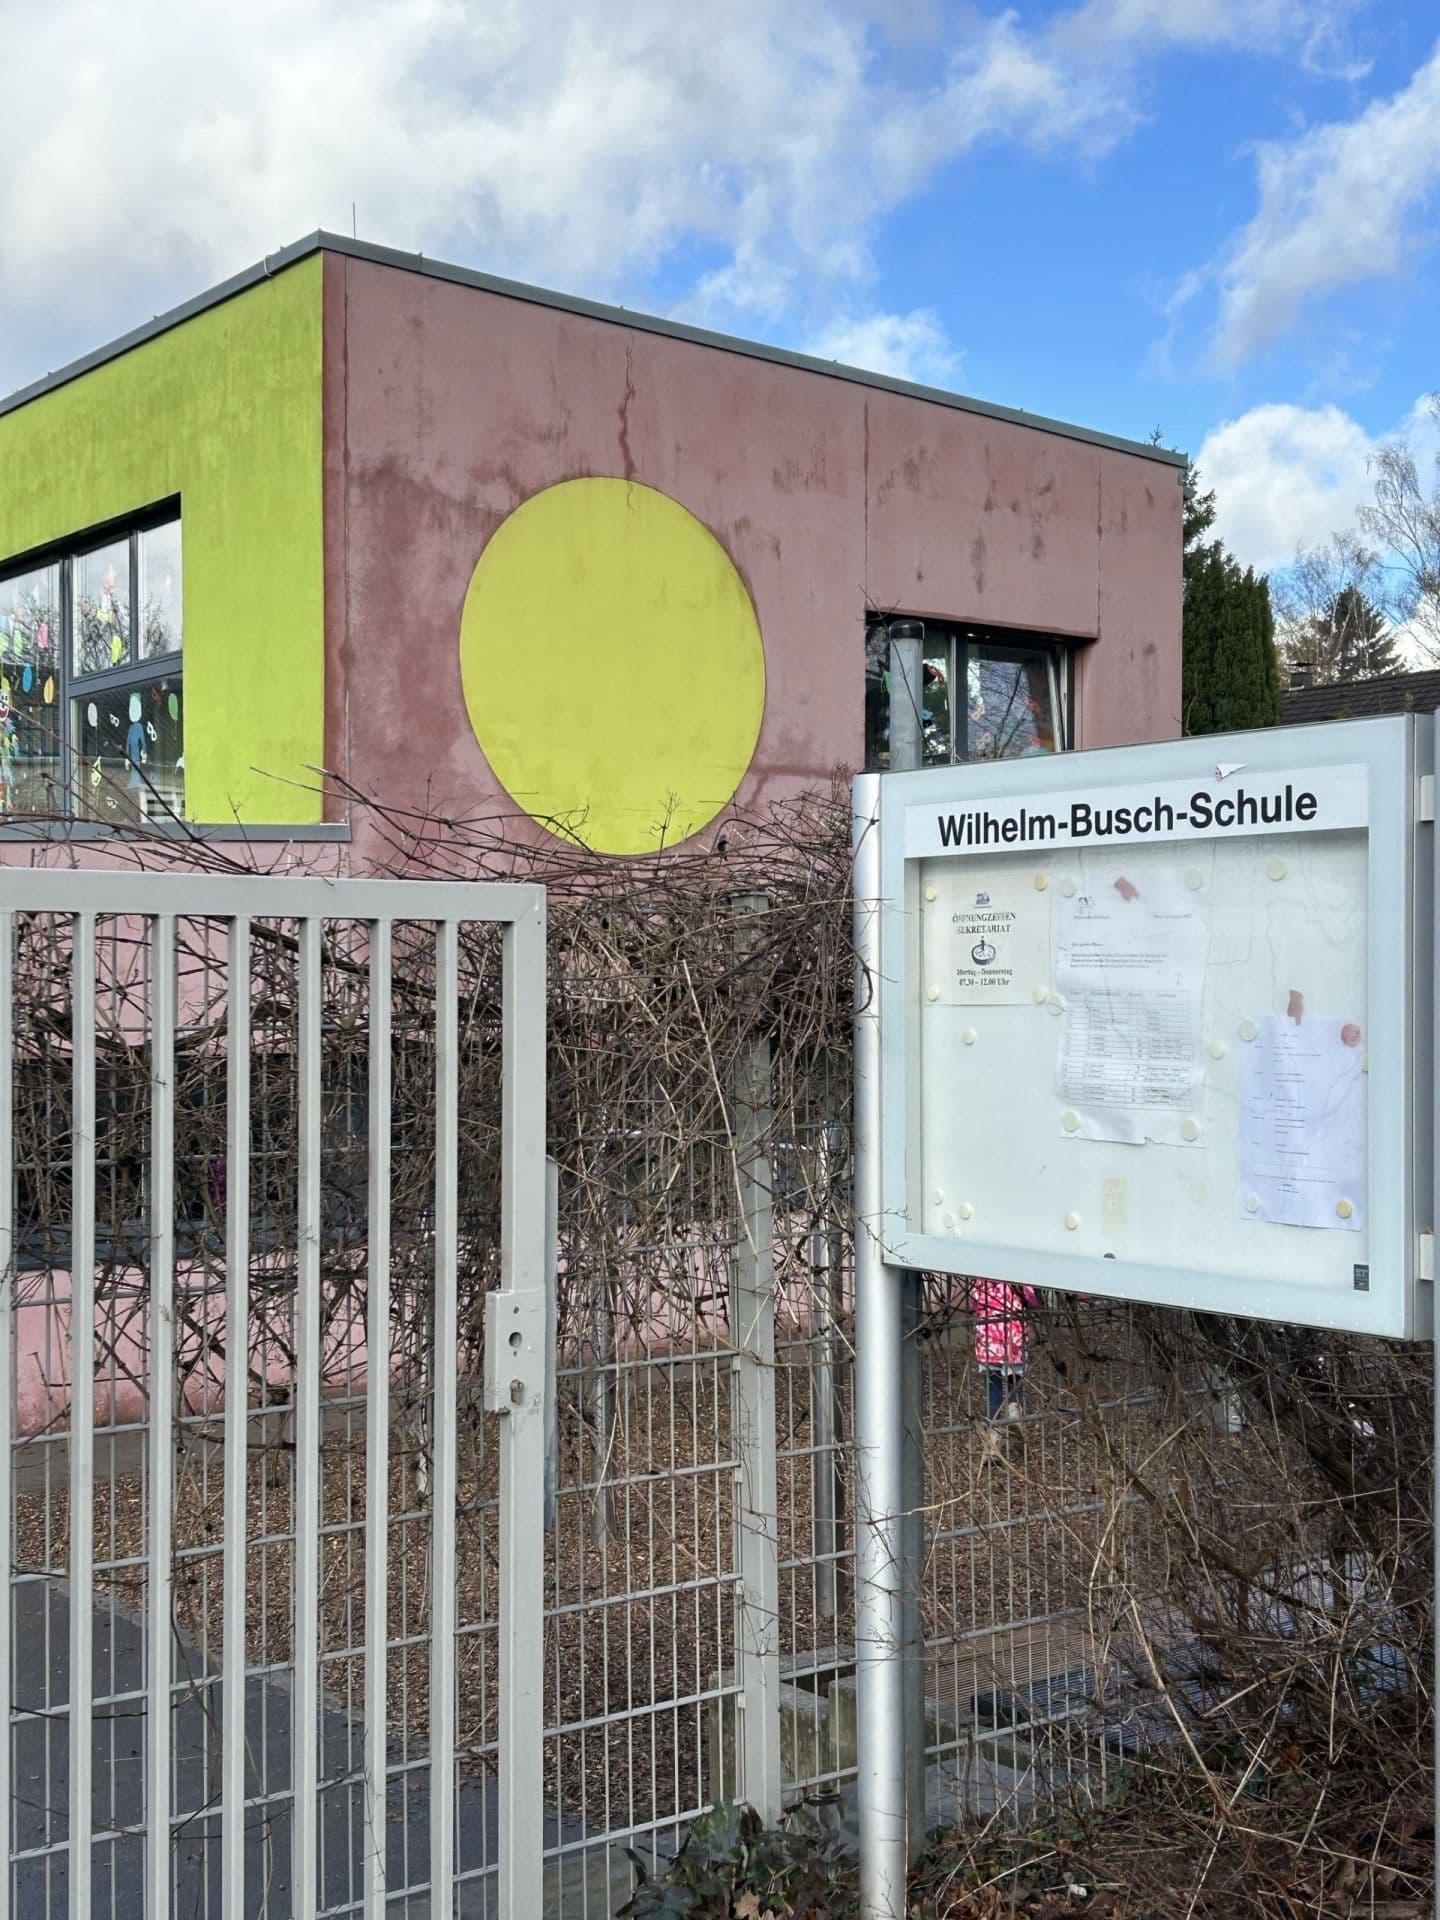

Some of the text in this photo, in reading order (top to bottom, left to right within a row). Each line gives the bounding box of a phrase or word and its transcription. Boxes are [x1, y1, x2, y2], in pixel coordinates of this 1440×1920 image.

[938, 785, 1318, 847] Wilhelm-Busch-Schule
[957, 924, 1011, 934] SEKRETARIAT
[981, 968, 1013, 976] Donnerstag
[997, 978, 1010, 986] Uhr
